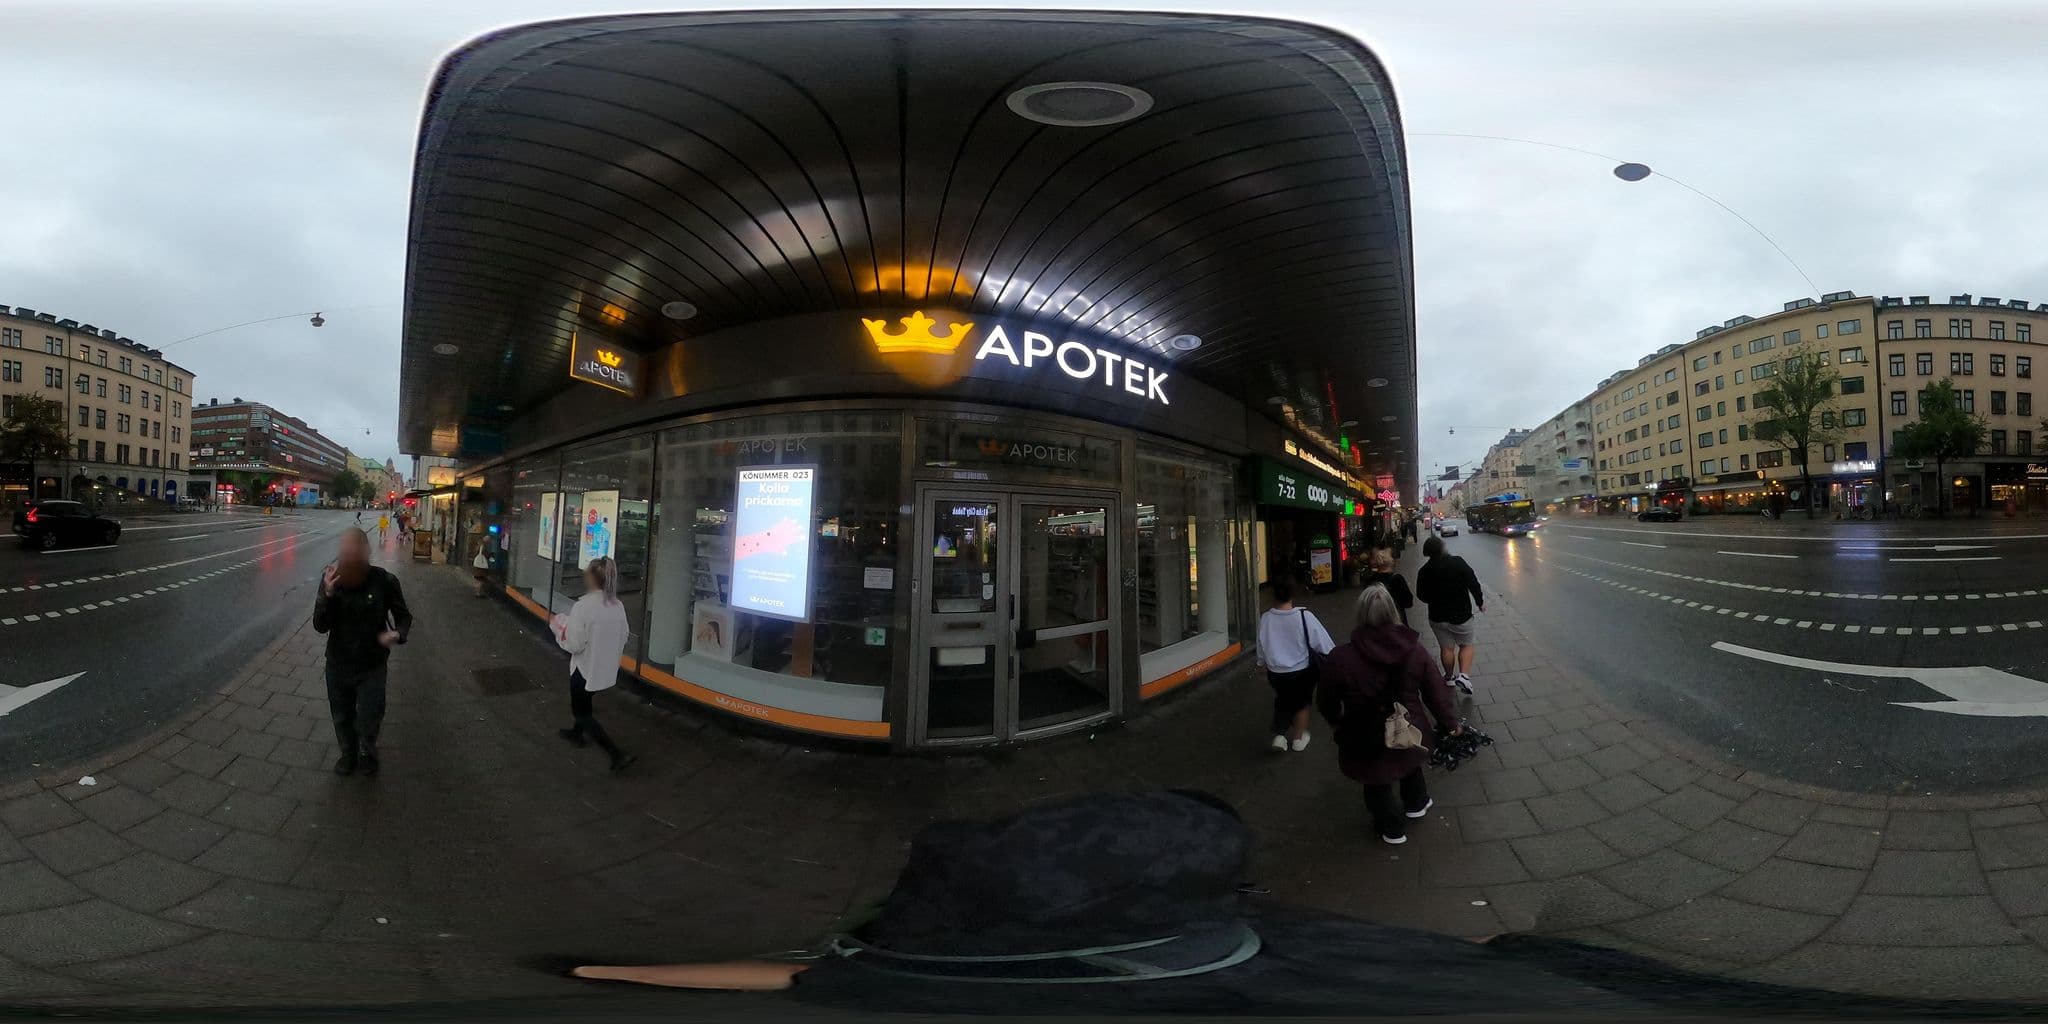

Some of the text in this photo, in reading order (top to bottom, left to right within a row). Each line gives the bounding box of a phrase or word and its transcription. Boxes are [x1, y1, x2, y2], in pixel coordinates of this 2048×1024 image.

[975, 325, 1170, 405] APOTEK
[739, 438, 807, 454] APOEK
[1009, 442, 1079, 464] APOTEK
[743, 471, 809, 480] KÖNUMMER 023
[759, 482, 789, 494] Kolla
[1307, 485, 1328, 506] coop
[745, 495, 804, 509] prickarna
[729, 701, 769, 716] APOTEK
